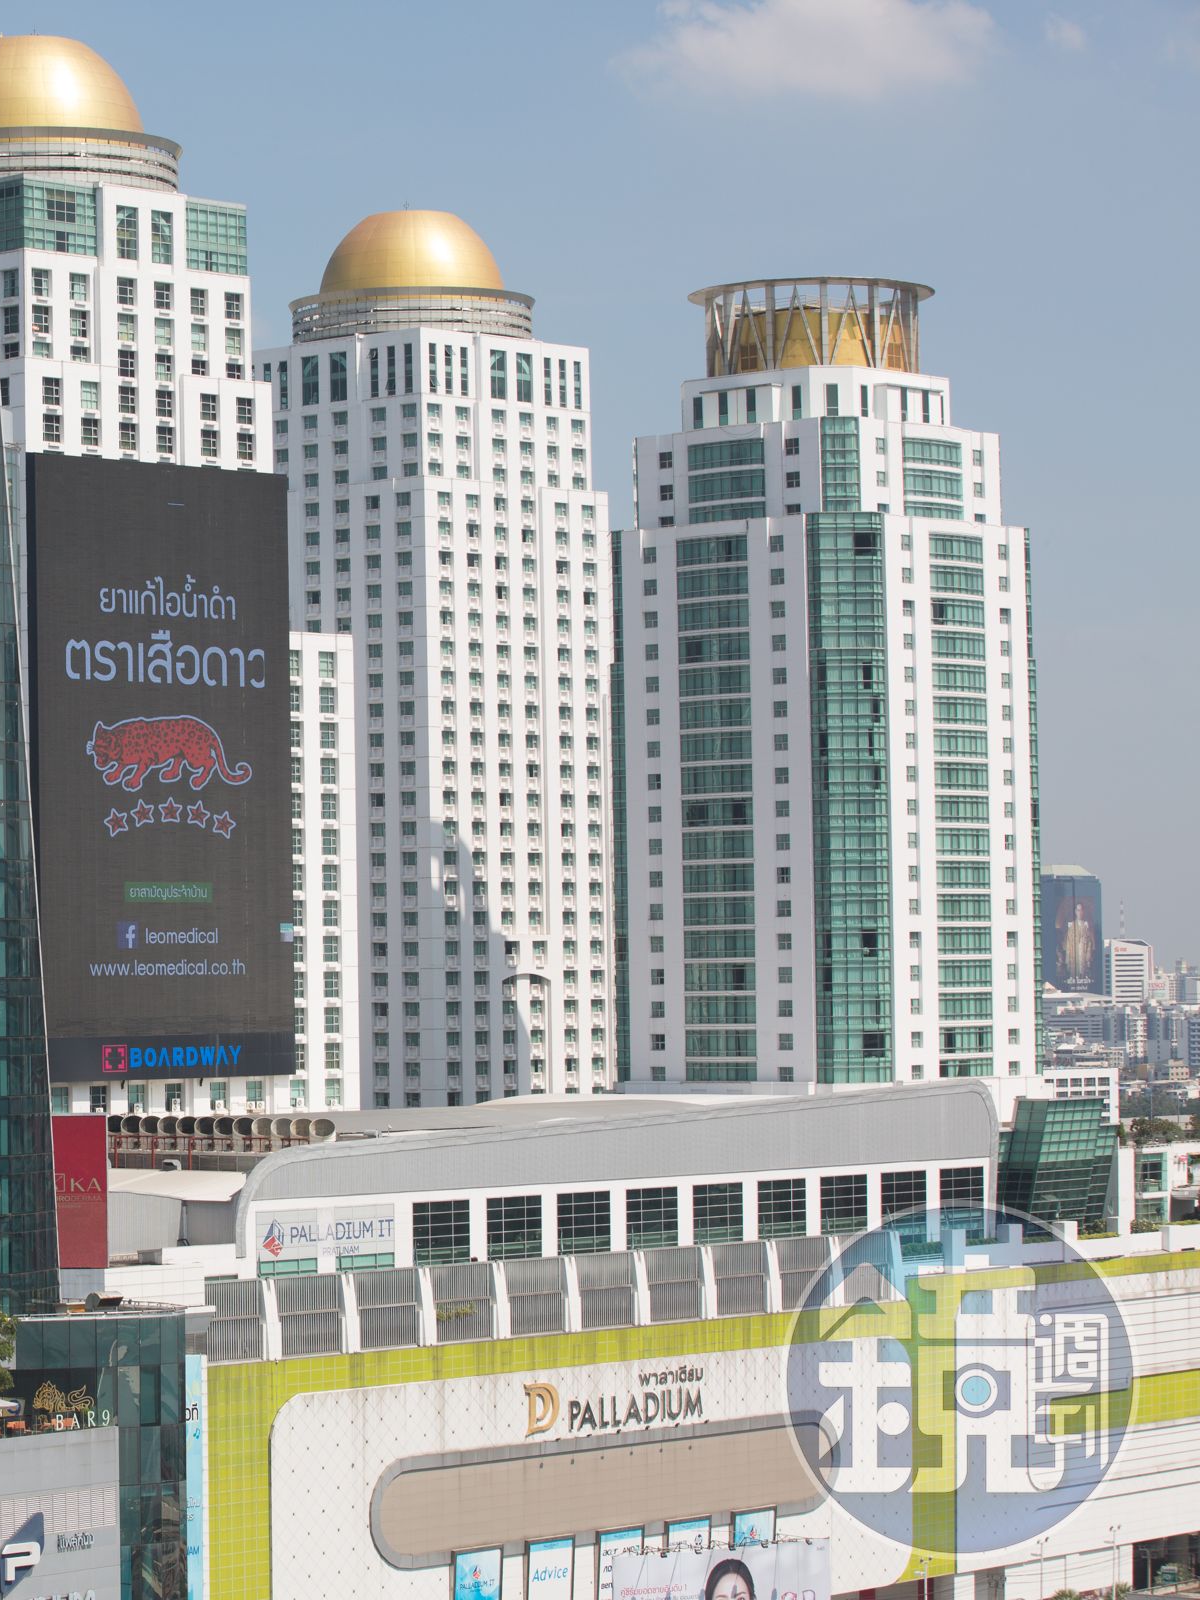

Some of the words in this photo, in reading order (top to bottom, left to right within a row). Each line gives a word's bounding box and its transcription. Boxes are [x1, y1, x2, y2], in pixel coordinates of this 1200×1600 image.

[99, 574, 237, 621] ยาแก้ไอน้ำดำ
[64, 629, 266, 689] ตราเสือดาว
[144, 927, 219, 945] leomedical
[89, 959, 246, 977] www.leomedical.co.th
[129, 1045, 242, 1069] BOARDWAY
[290, 1220, 374, 1244] PALLADIUM
[378, 1219, 394, 1238] IT
[567, 1386, 704, 1433] PALLADIUM
[531, 1565, 569, 1583] Advice
